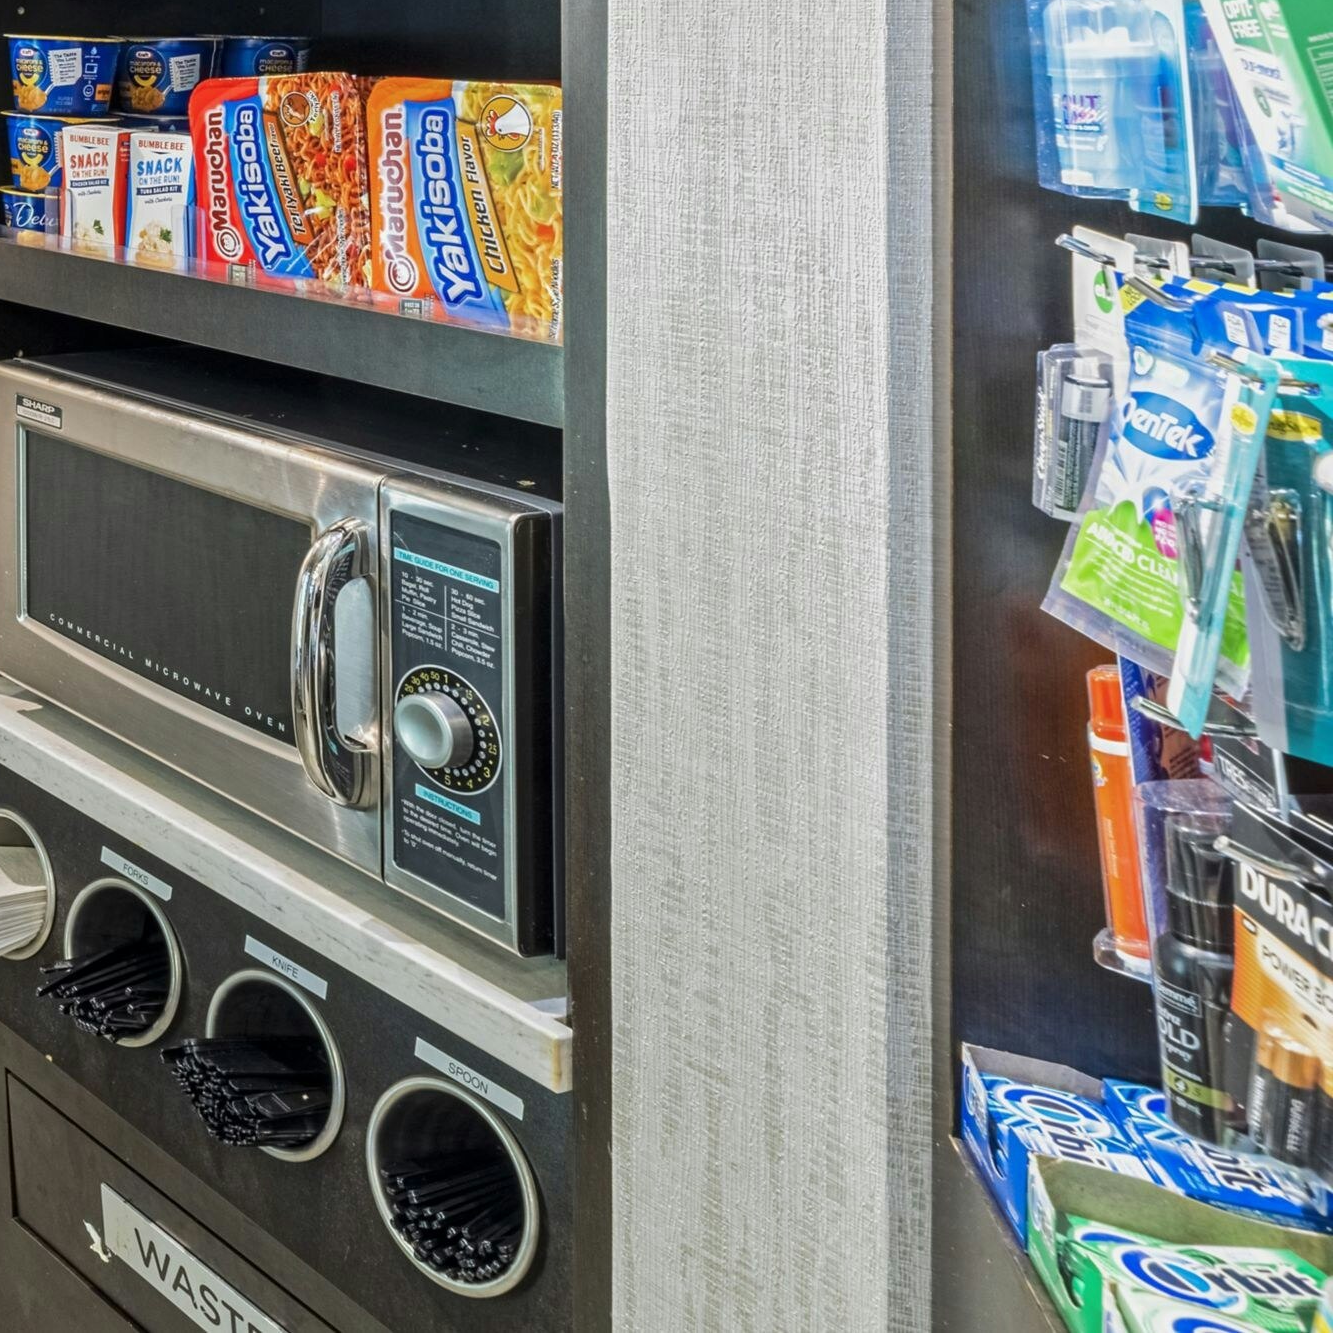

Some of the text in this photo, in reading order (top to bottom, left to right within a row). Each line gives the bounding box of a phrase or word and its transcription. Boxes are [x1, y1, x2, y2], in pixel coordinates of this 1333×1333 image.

[1230, 19, 1263, 40] FREE
[69, 135, 109, 146] BUMBLE BEE
[137, 139, 185, 151] BUMBLE BEE
[69, 151, 109, 170] SNACK
[136, 156, 183, 177] SNACK
[71, 169, 107, 178] ON THE RUN!
[138, 175, 180, 185] ON THE RUN!
[154, 186, 170, 194] SALAD
[236, 109, 288, 270] Yakisoba
[274, 142, 306, 236] Teriyaki Beef
[421, 114, 477, 303] Yakisoba
[461, 135, 507, 275] Chicken Flavor
[22, 398, 55, 414] SHARP
[398, 551, 495, 589] TIME GUIDE FOR ONE SERVING
[466, 609, 481, 620] Slice
[467, 617, 495, 633] Sandwich
[417, 625, 443, 641] Sandwich
[49, 613, 285, 732] COMMERCIAL MICROWAVE OVEN
[422, 790, 474, 819] INSTRUCTIONS
[454, 832, 470, 843] Oven
[122, 861, 150, 887] FORKS
[1238, 861, 1333, 960] DURAC
[271, 955, 300, 980] KNIFE
[1261, 946, 1311, 996] POWER
[1158, 1019, 1201, 1052] OLD
[446, 1060, 490, 1096] SPOON
[134, 1227, 263, 1333] WAST
[1121, 1248, 1325, 1311] Orbit
